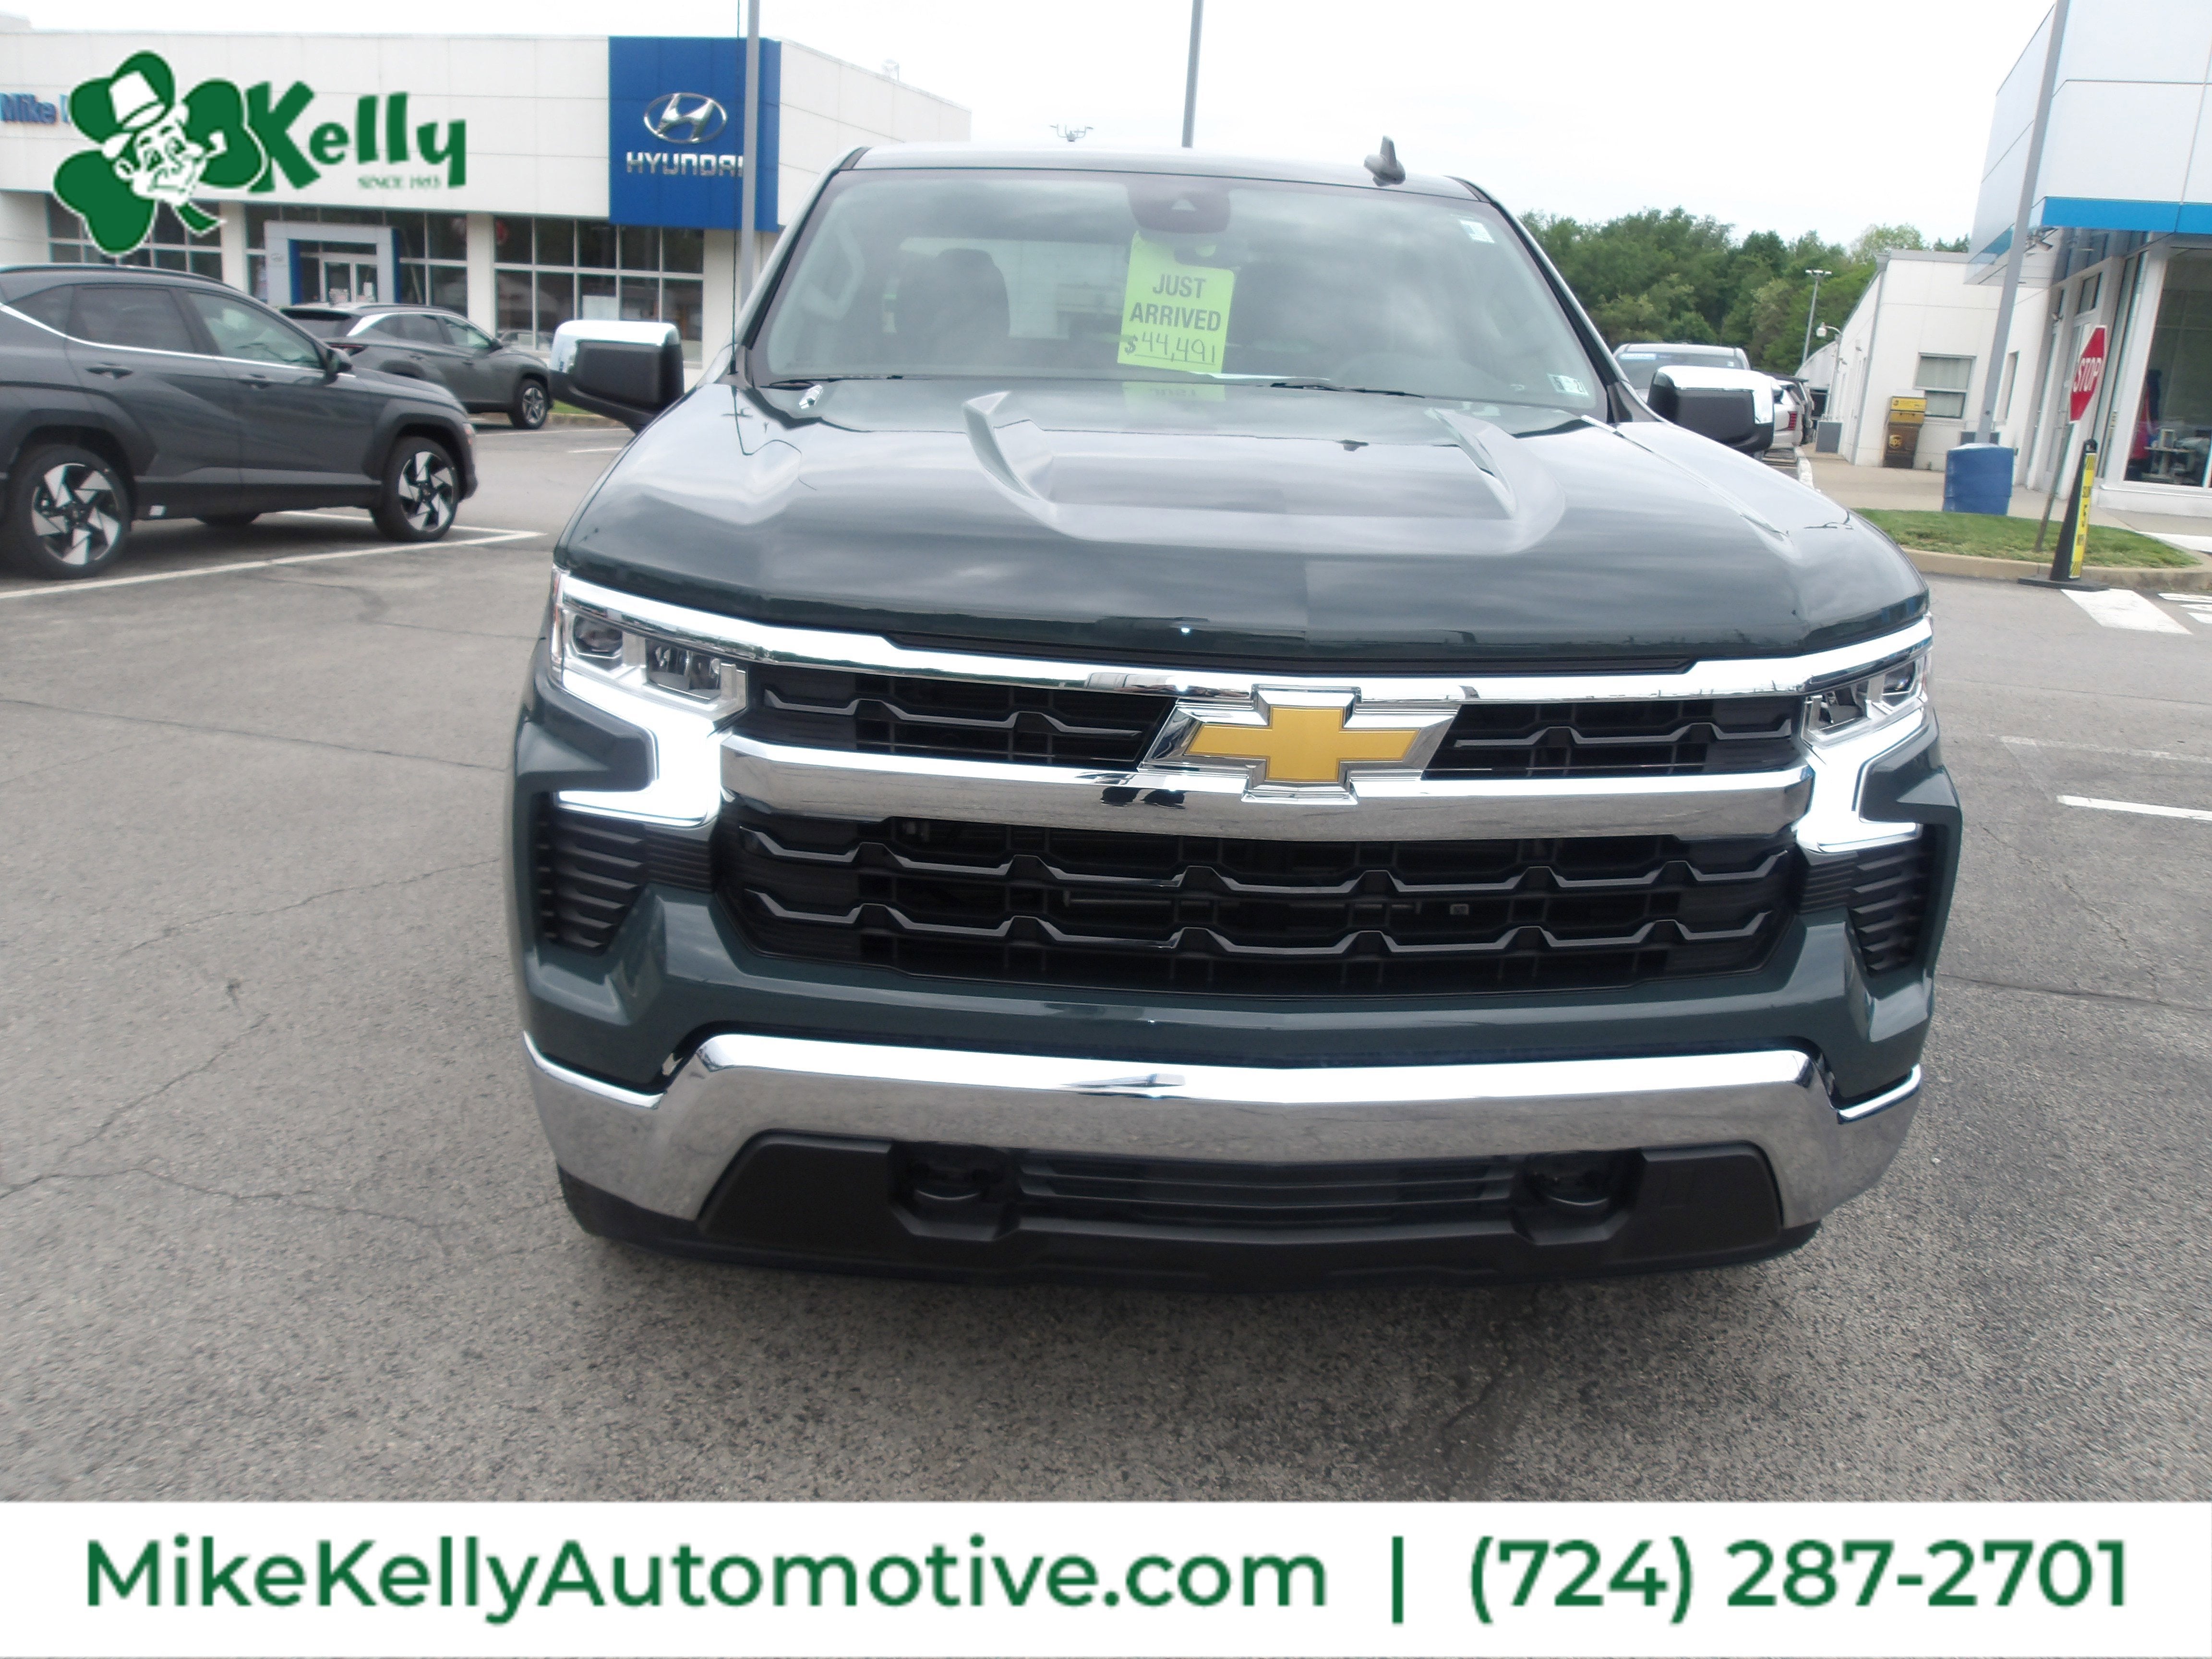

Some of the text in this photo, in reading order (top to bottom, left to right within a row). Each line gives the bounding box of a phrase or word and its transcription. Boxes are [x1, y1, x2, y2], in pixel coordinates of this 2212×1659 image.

[626, 152, 744, 177] HYUNDAI
[1153, 274, 1206, 299] JUST
[1129, 301, 1222, 332] ARRIVED
[2073, 357, 2103, 393] STOP
